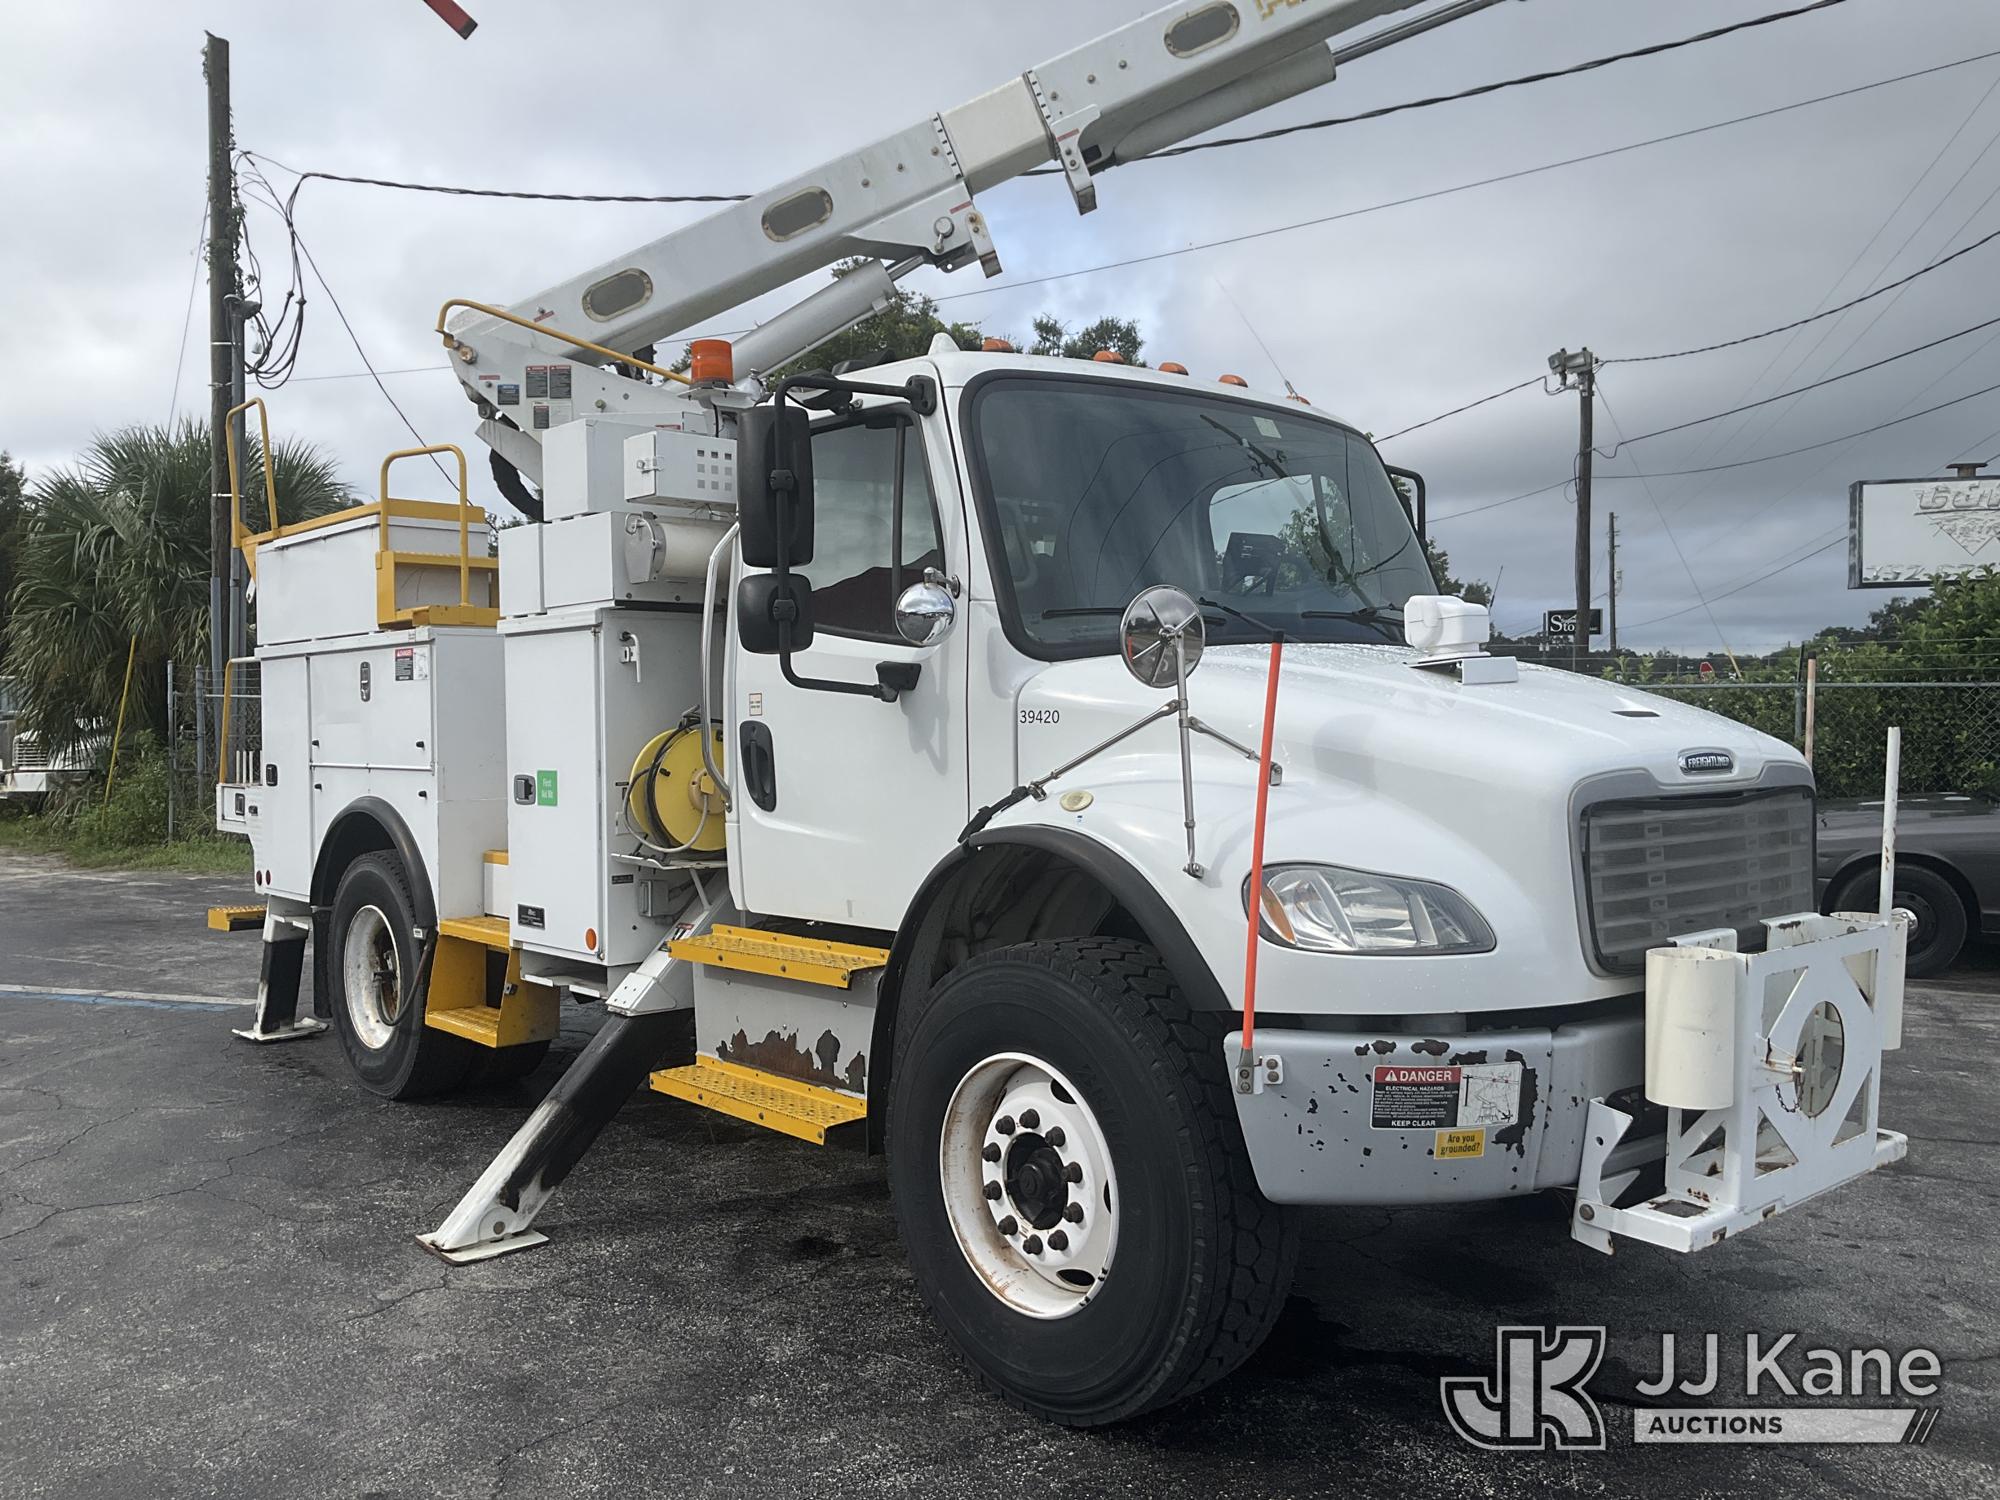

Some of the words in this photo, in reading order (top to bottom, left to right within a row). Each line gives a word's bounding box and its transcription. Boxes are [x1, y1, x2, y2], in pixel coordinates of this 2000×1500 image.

[1550, 614, 1577, 632] Sto
[1019, 709, 1060, 724] 39420
[1687, 755, 1730, 768] FREIGHTLINER
[1399, 1070, 1452, 1082] DANGER
[1447, 1134, 1460, 1143] Are
[1462, 1134, 1475, 1143] you
[1440, 1142, 1480, 1155] grounded?
